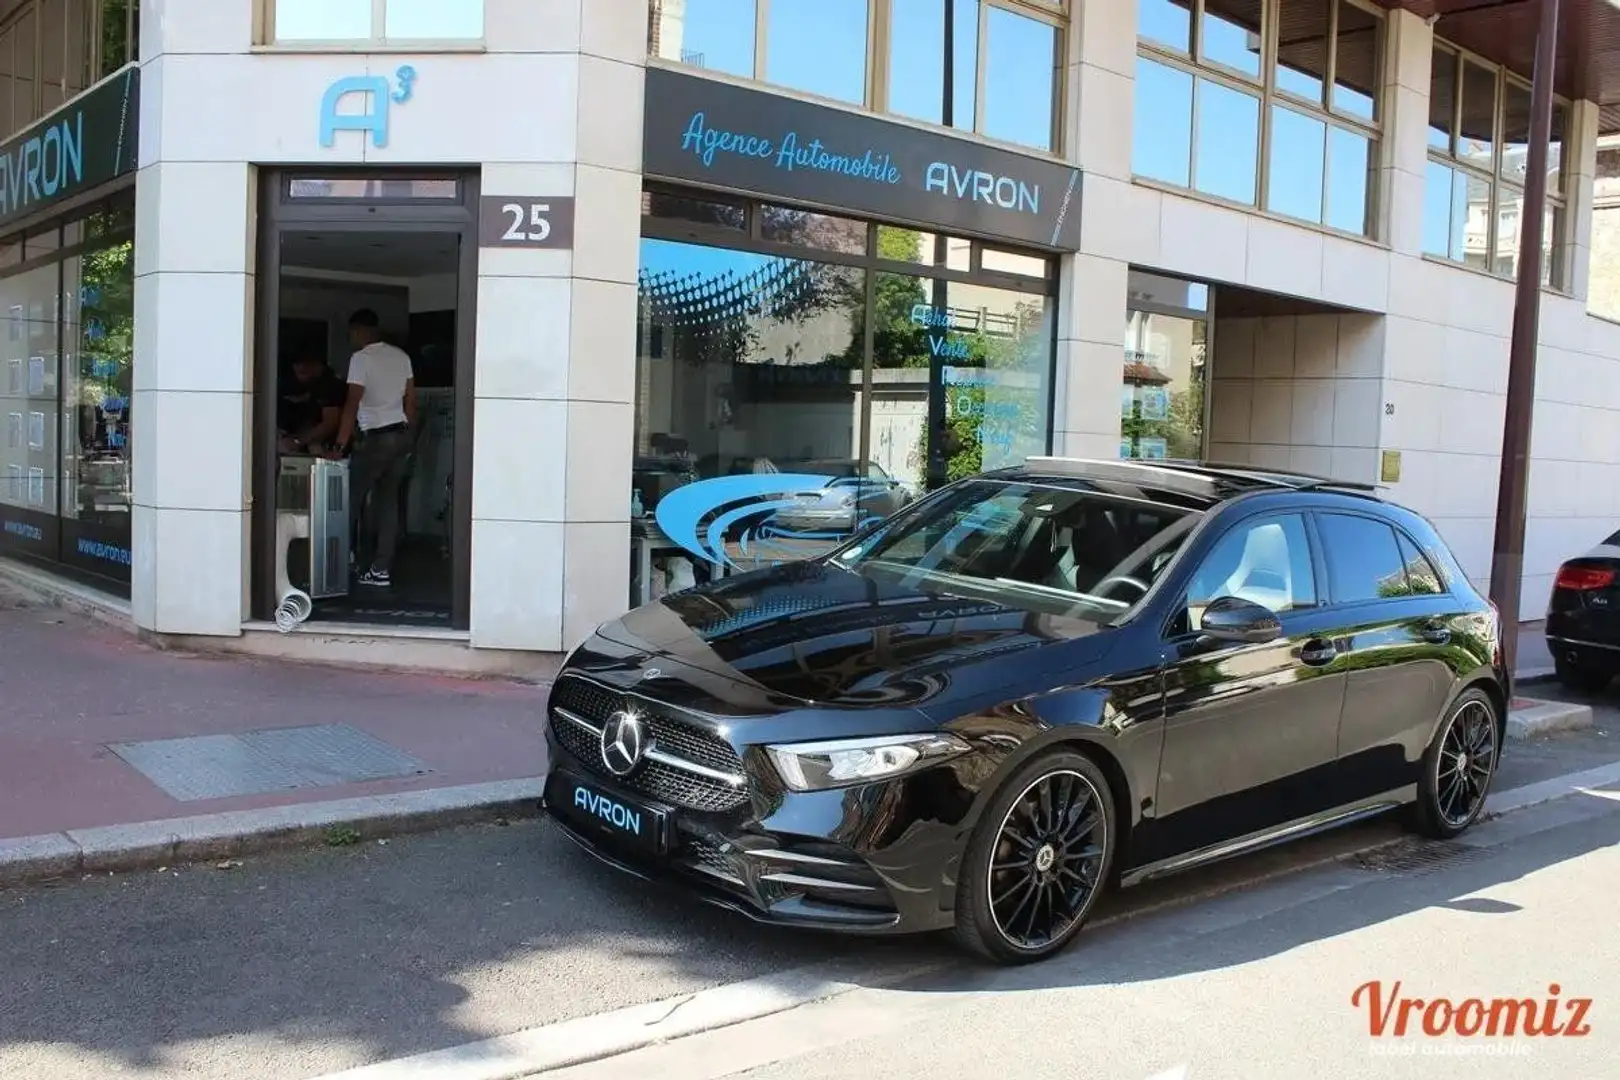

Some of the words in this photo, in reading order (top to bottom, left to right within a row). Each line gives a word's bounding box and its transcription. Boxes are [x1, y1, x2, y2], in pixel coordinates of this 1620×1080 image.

[681, 112, 774, 167] Agence
[775, 131, 902, 184] Automobile
[925, 161, 1040, 214] AVRON
[501, 203, 551, 241] 25
[574, 786, 641, 835] AVRON
